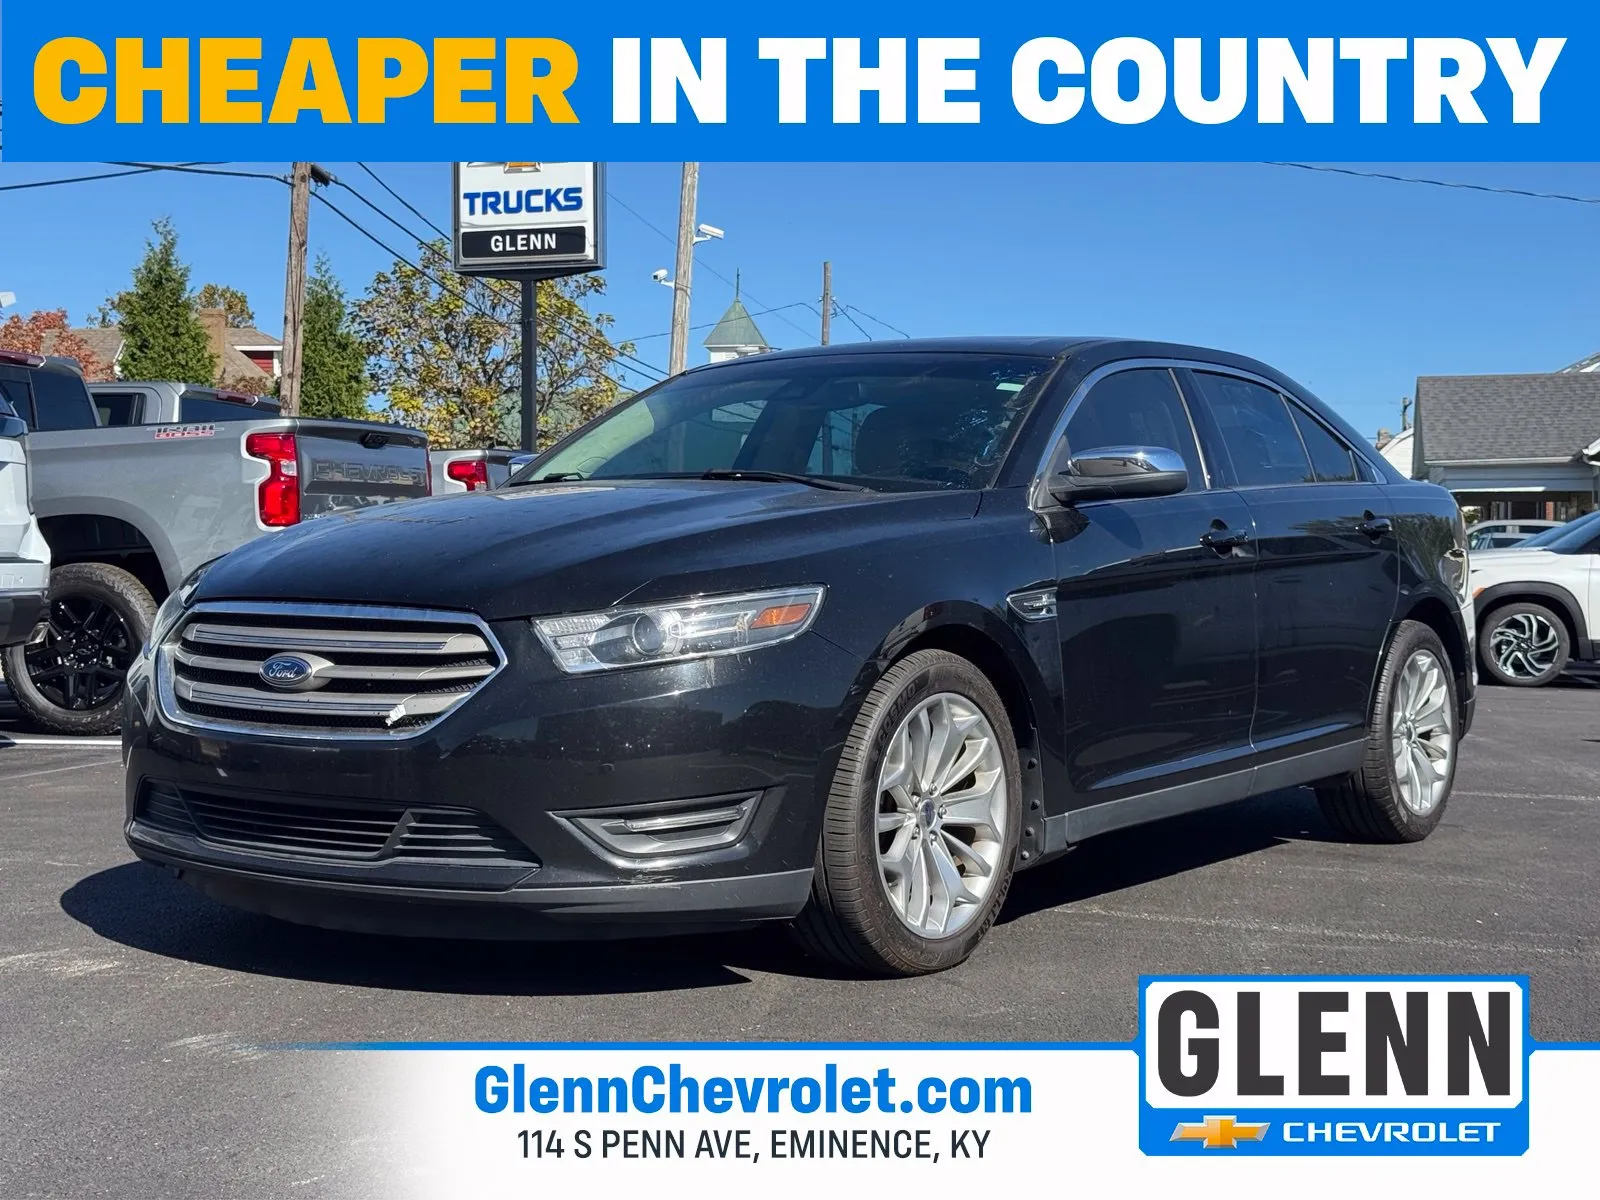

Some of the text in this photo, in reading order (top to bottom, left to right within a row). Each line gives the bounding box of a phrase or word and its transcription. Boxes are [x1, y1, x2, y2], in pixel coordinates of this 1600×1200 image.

[463, 187, 583, 216] TRUCKS
[490, 233, 557, 252] GLENN
[268, 661, 298, 679] Ford
